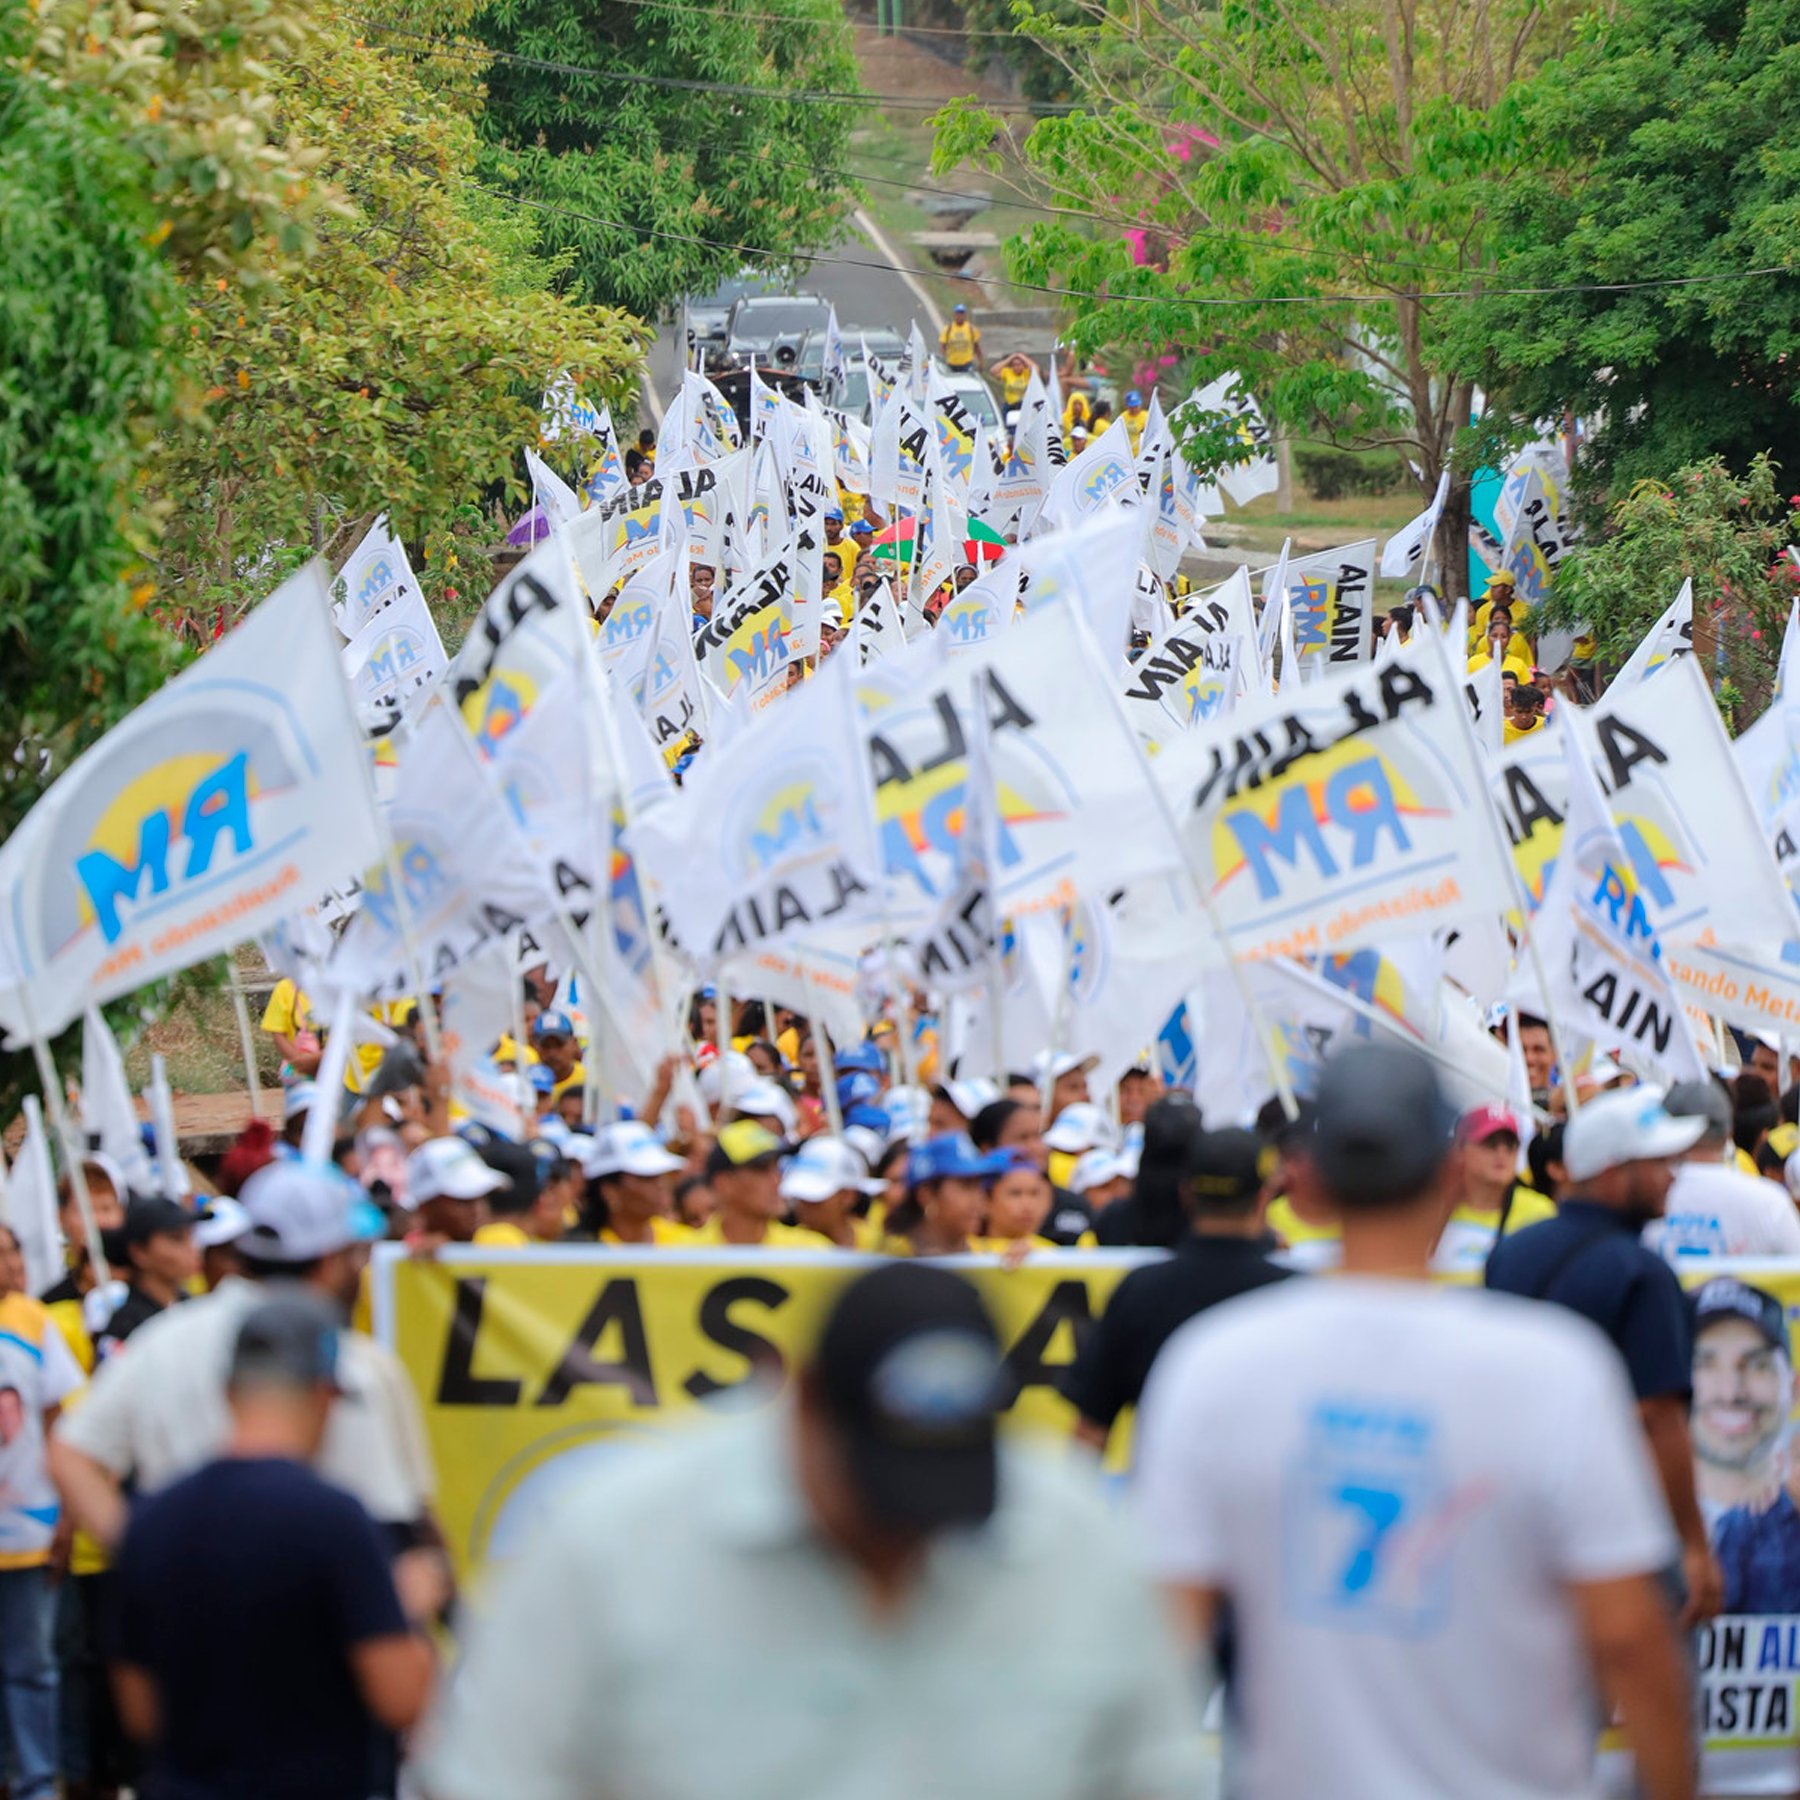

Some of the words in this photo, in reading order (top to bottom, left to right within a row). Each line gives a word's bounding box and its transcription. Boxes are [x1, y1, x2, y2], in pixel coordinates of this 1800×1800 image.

[1290, 583, 1327, 643] RM
[1330, 563, 1368, 663] ALAIN
[437, 1275, 789, 1413] LAS
